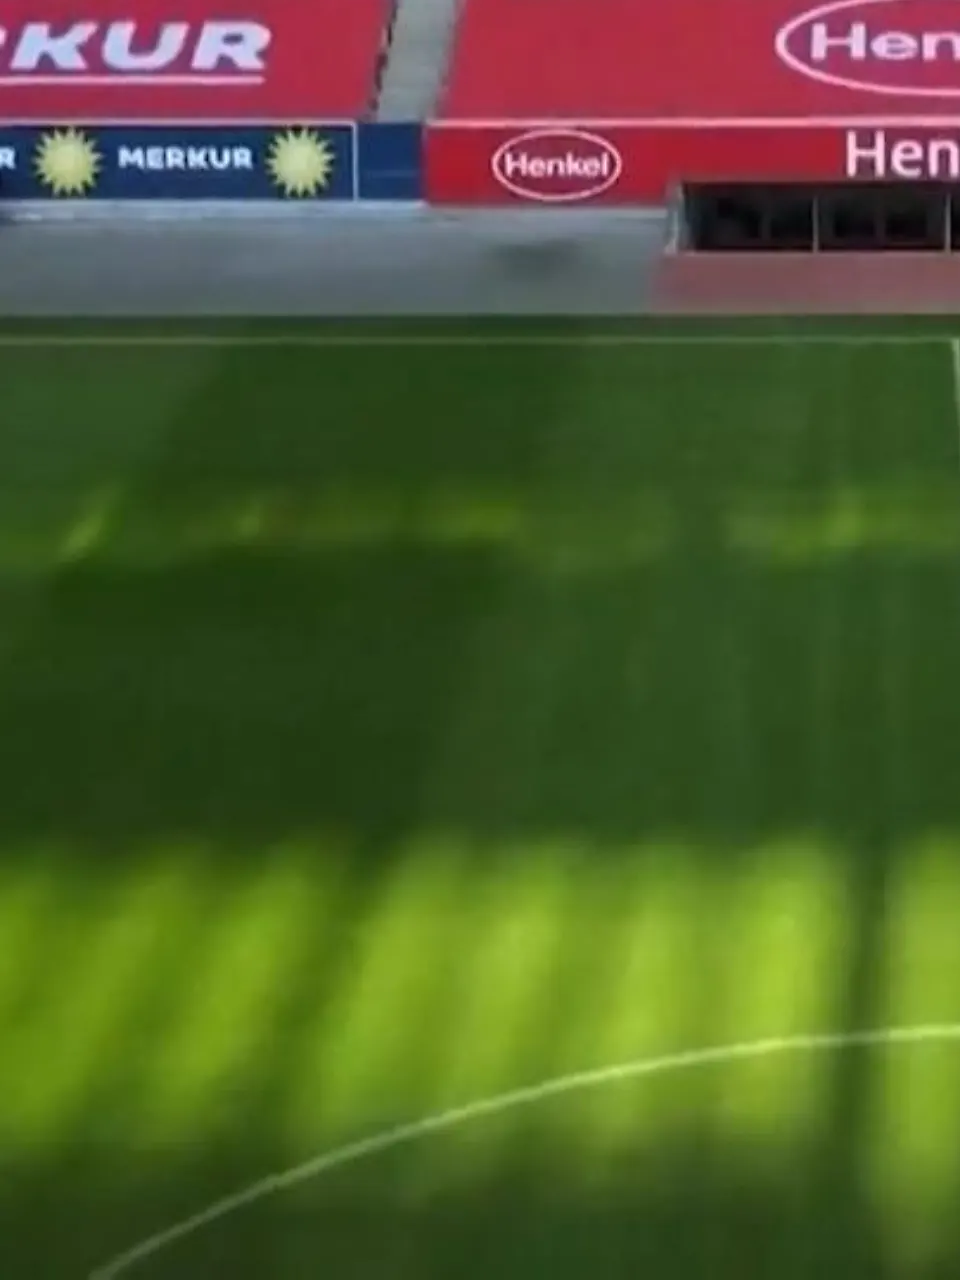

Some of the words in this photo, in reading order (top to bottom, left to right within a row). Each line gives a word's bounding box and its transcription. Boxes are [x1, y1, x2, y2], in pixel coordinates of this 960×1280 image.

[0, 20, 272, 70] KUR
[117, 146, 254, 170] MERKUR
[503, 152, 611, 177] Henkel
